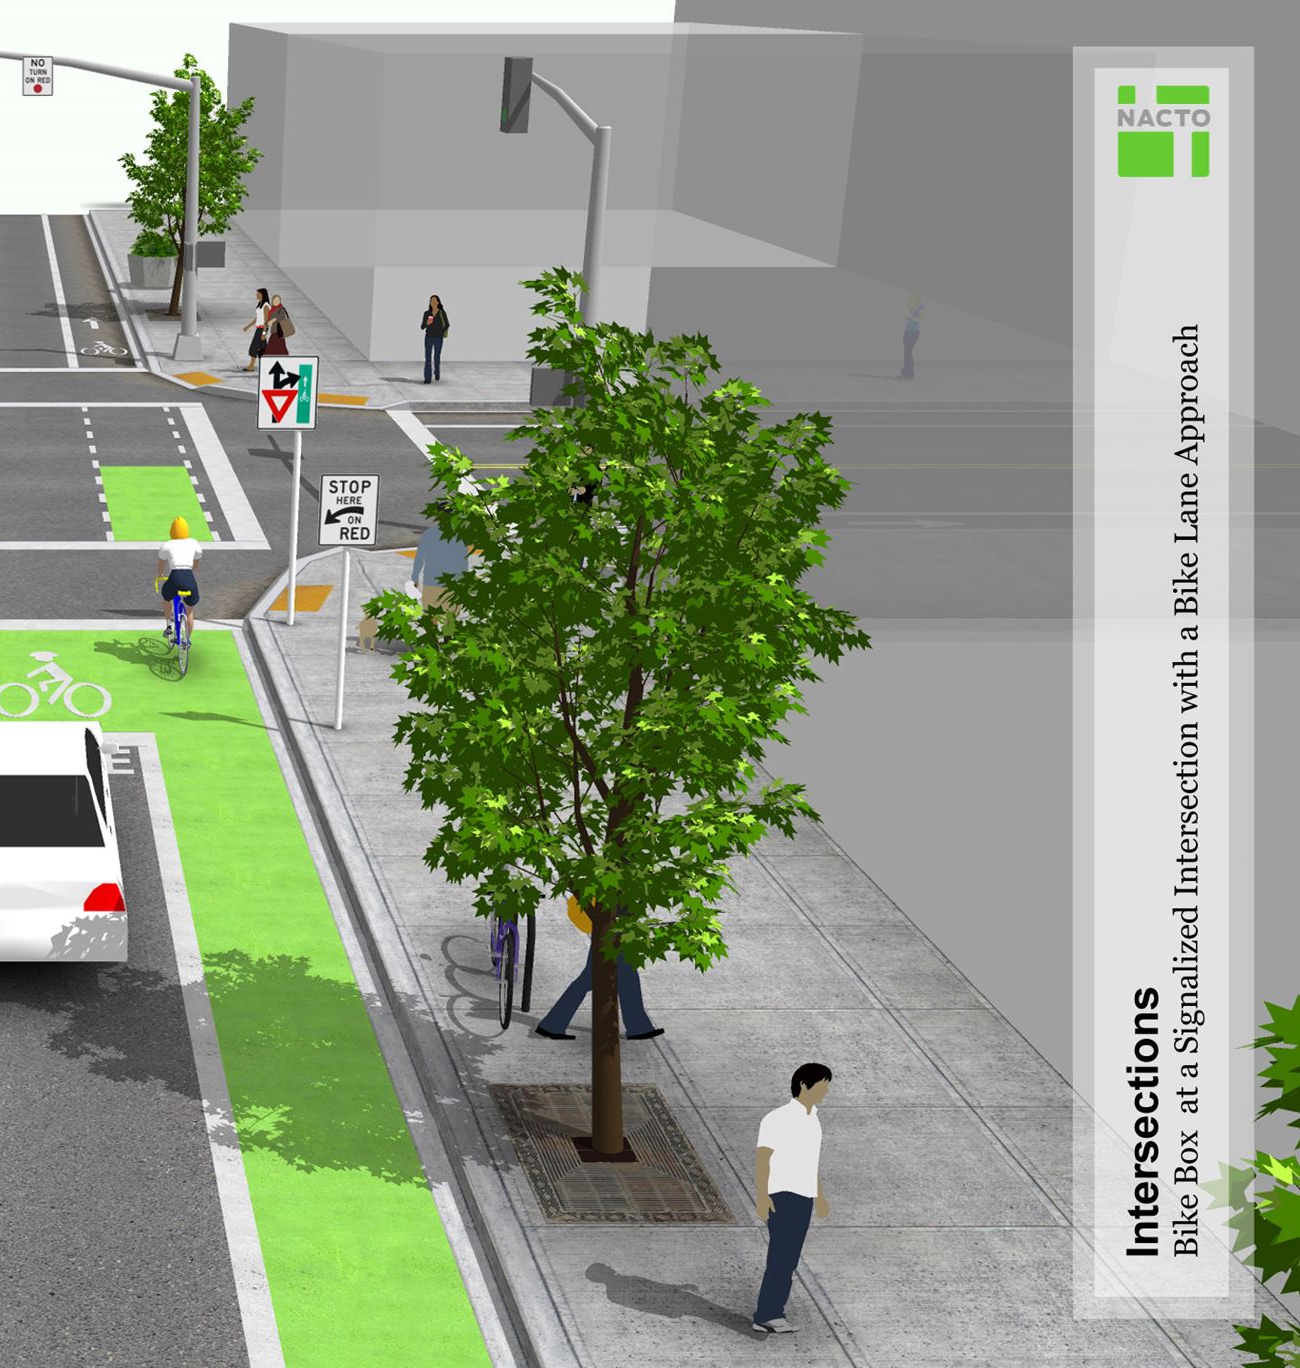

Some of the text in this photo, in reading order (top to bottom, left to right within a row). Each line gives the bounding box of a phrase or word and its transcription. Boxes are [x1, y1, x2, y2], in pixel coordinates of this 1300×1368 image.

[30, 58, 45, 67] NO
[25, 76, 51, 84] ON RED
[329, 480, 371, 494] STOP
[336, 496, 362, 505] HERE
[347, 516, 361, 524] ON
[340, 527, 370, 540] RED
